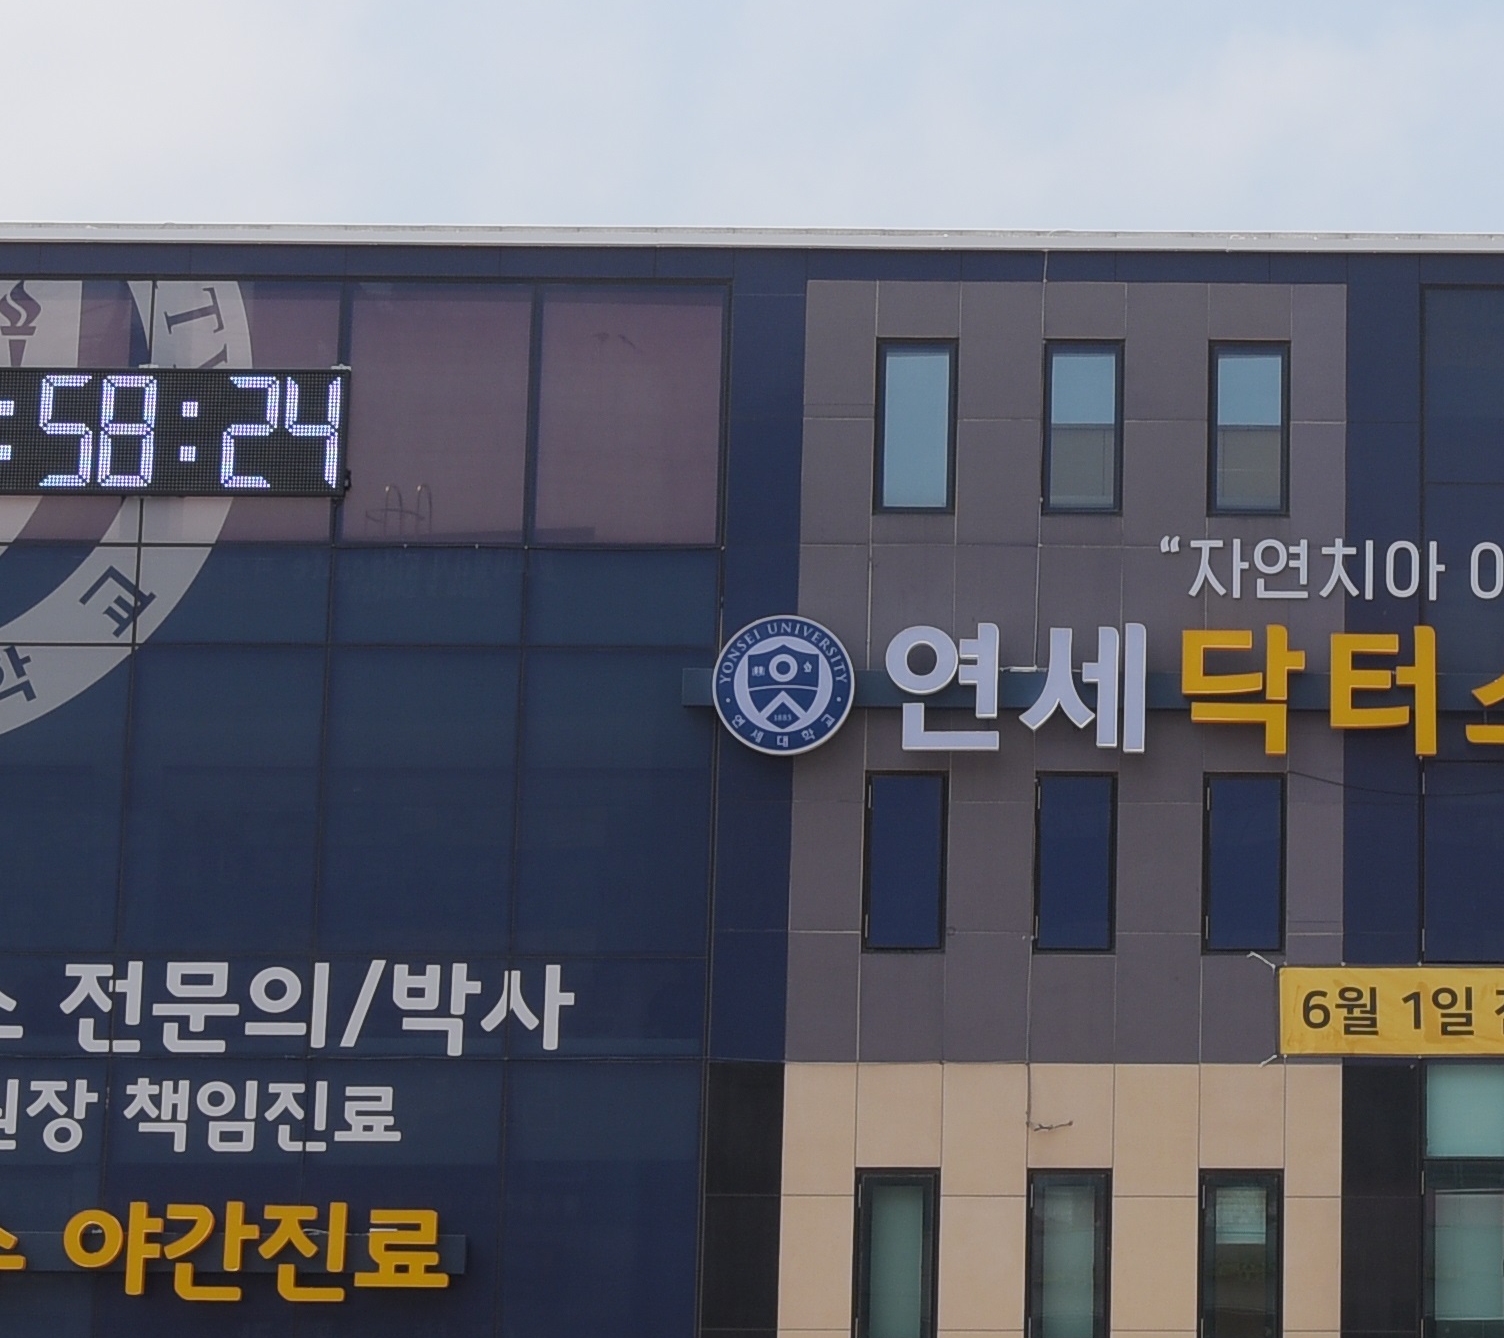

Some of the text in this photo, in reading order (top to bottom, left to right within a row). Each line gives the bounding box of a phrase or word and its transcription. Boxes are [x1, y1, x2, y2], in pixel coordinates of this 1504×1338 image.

[719, 621, 849, 685] YONSEI UNIVERSITY
[59, 960, 575, 1057] 전문의/박사
[1301, 986, 1381, 1033] 6월
[1401, 986, 1477, 1035] 1일
[122, 1078, 403, 1153] 책임진료
[62, 1199, 452, 1304] 야간진료
